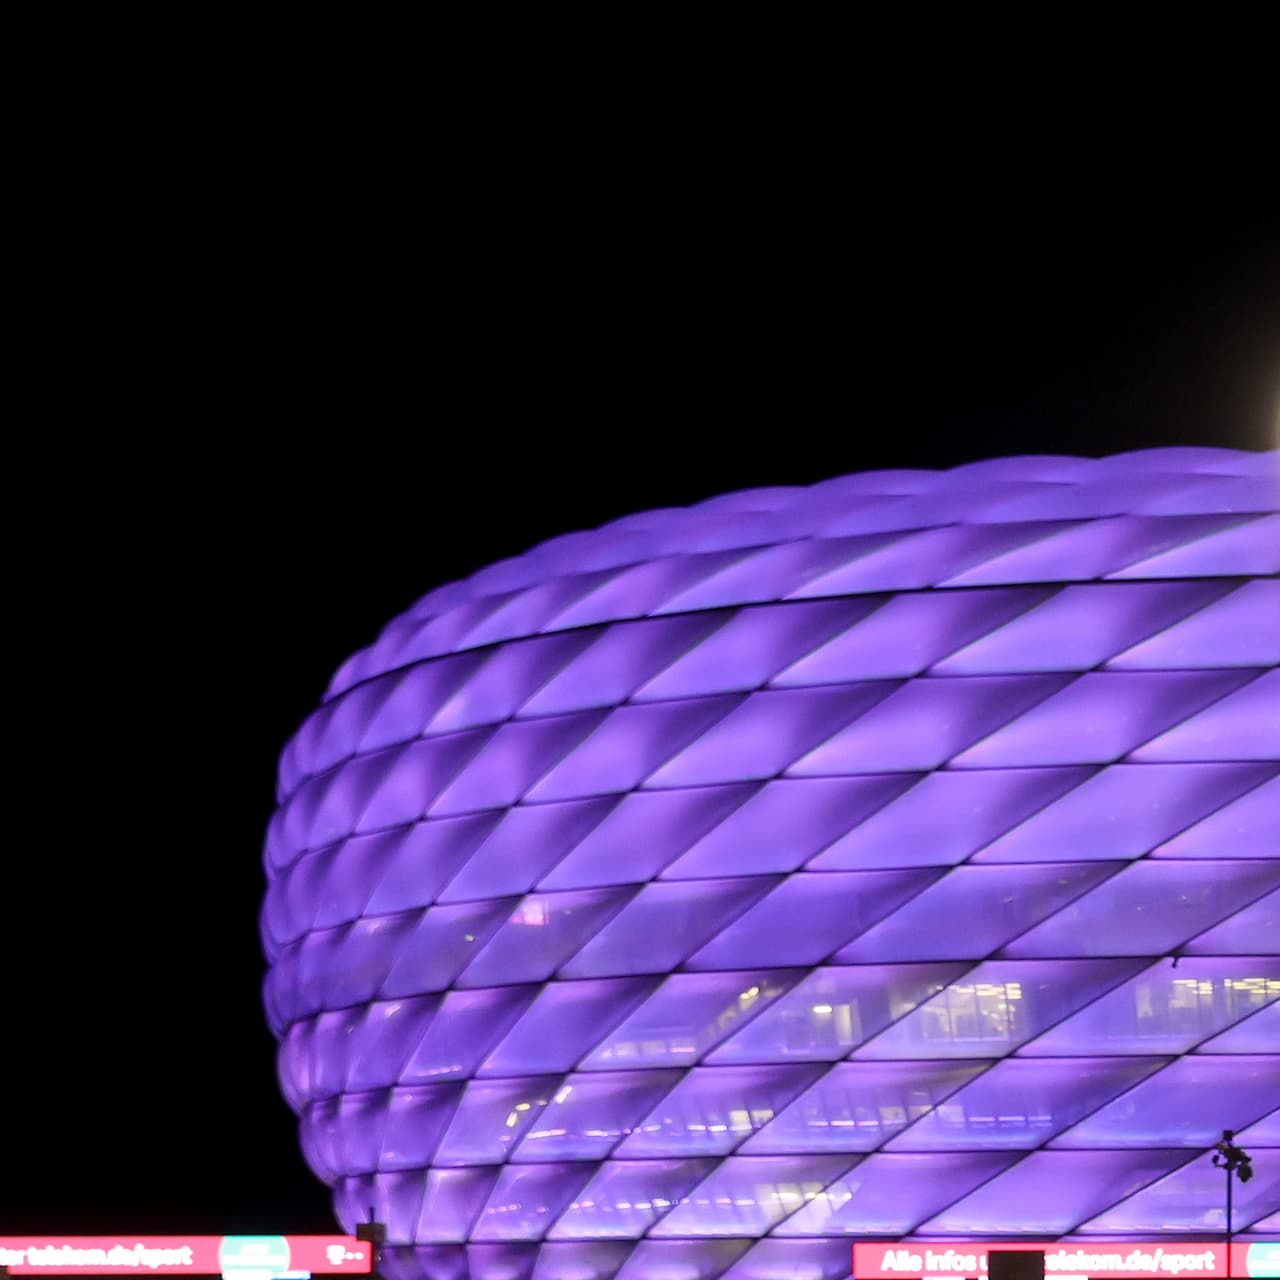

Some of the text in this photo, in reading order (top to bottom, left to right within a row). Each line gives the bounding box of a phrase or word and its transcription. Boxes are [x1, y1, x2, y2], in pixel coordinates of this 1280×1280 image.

[881, 1250, 922, 1271] Alle
[925, 1250, 977, 1271] Infos
[1044, 1249, 1215, 1274] elekom.de/sport
